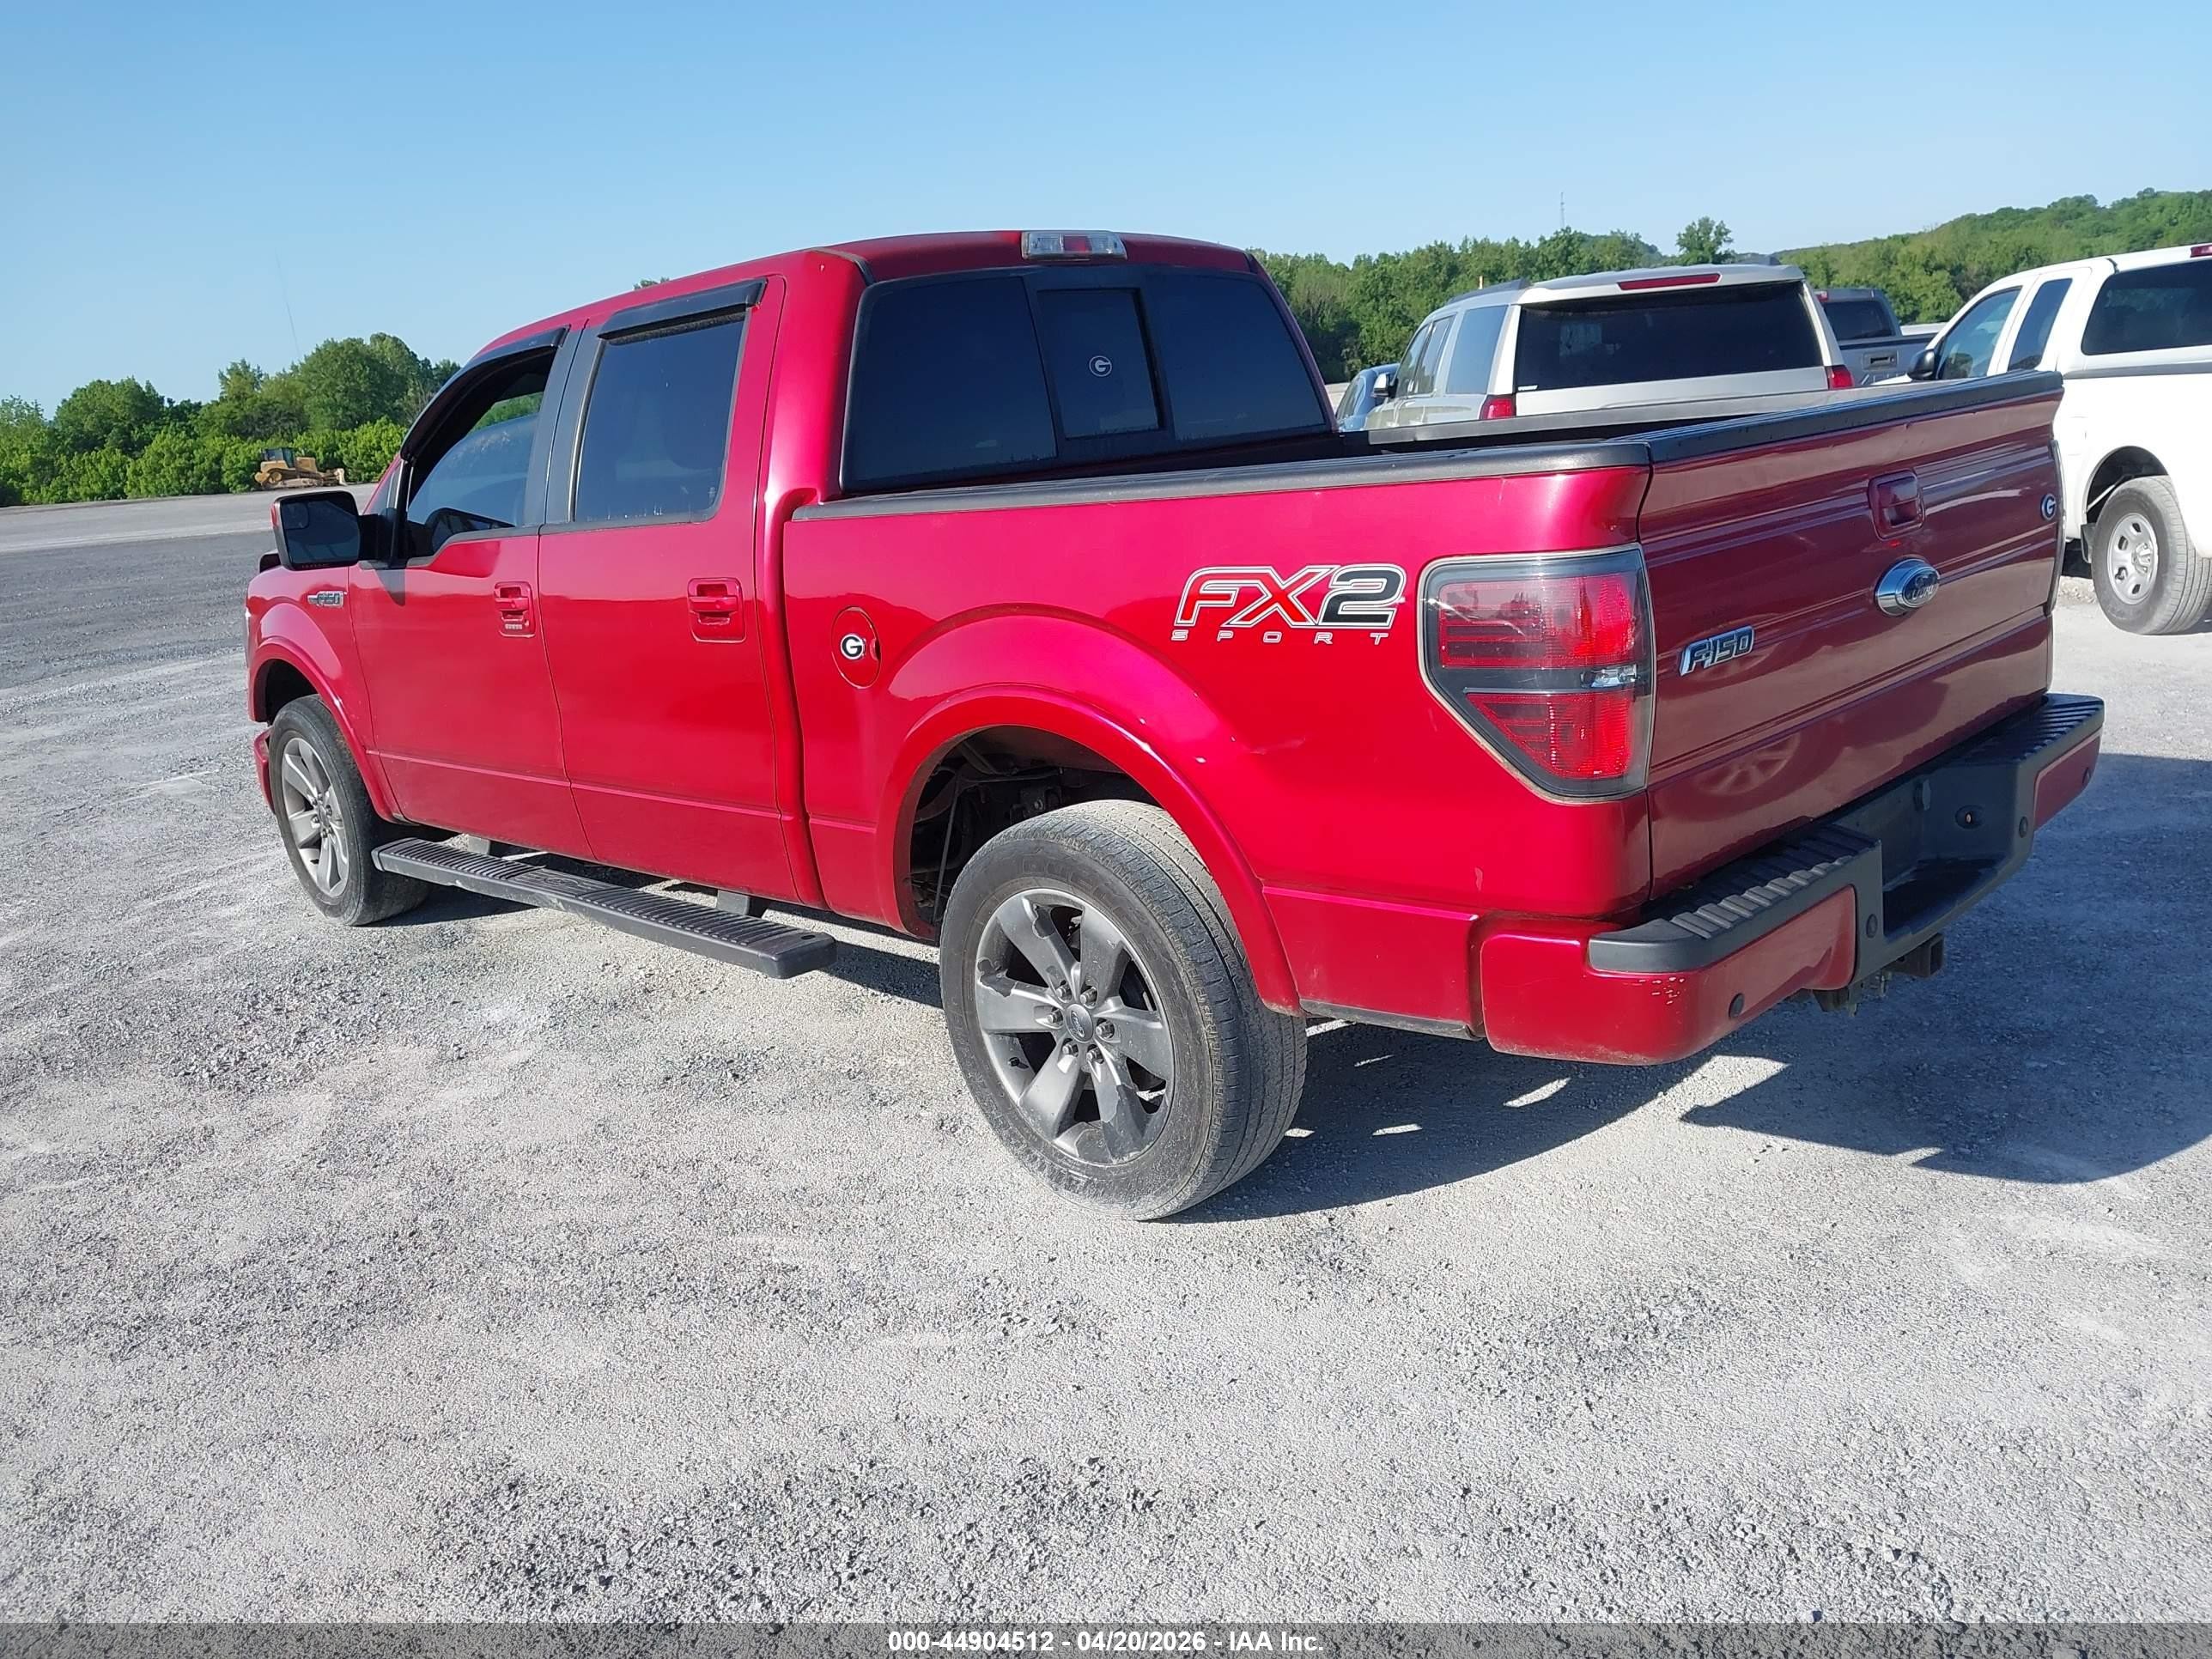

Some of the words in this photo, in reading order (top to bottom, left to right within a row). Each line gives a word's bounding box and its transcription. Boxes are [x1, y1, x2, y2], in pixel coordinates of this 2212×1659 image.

[2041, 494, 2057, 520] G
[1174, 563, 1407, 629] FX2
[840, 633, 865, 660] G
[1170, 629, 1389, 645] SPORT
